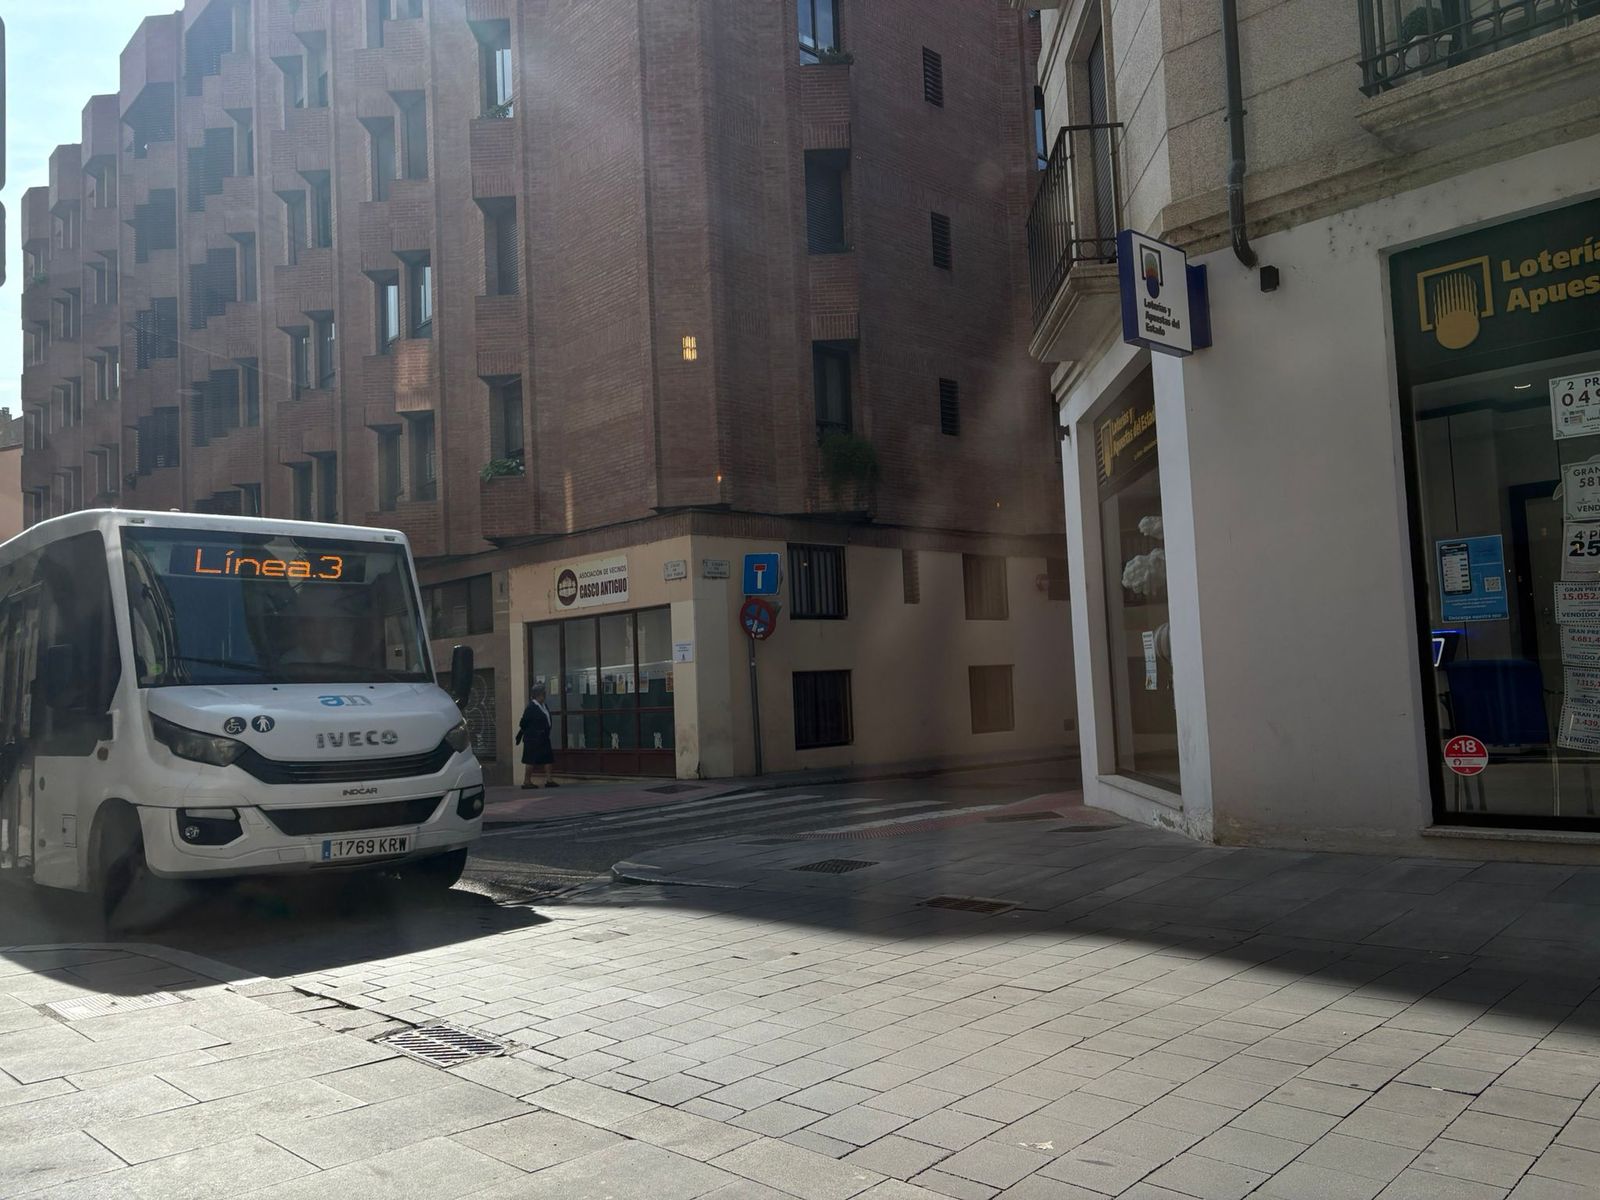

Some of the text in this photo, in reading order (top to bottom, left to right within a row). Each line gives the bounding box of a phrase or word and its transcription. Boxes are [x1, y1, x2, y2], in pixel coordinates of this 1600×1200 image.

[1506, 275, 1600, 313] Apues
[1144, 298, 1167, 313] Loterías
[1145, 311, 1180, 329] Apuestas del
[1145, 322, 1166, 336] Estado
[1589, 530, 1600, 540] P
[1569, 540, 1600, 557] 25
[603, 567, 609, 575] DE
[610, 565, 627, 574] VECINOS
[579, 577, 627, 599] CASCO ANTIGUO
[316, 730, 399, 749] IVECO
[1452, 740, 1477, 753] +18
[342, 787, 378, 796] INDCAR
[336, 837, 407, 856] 1769 KRW
